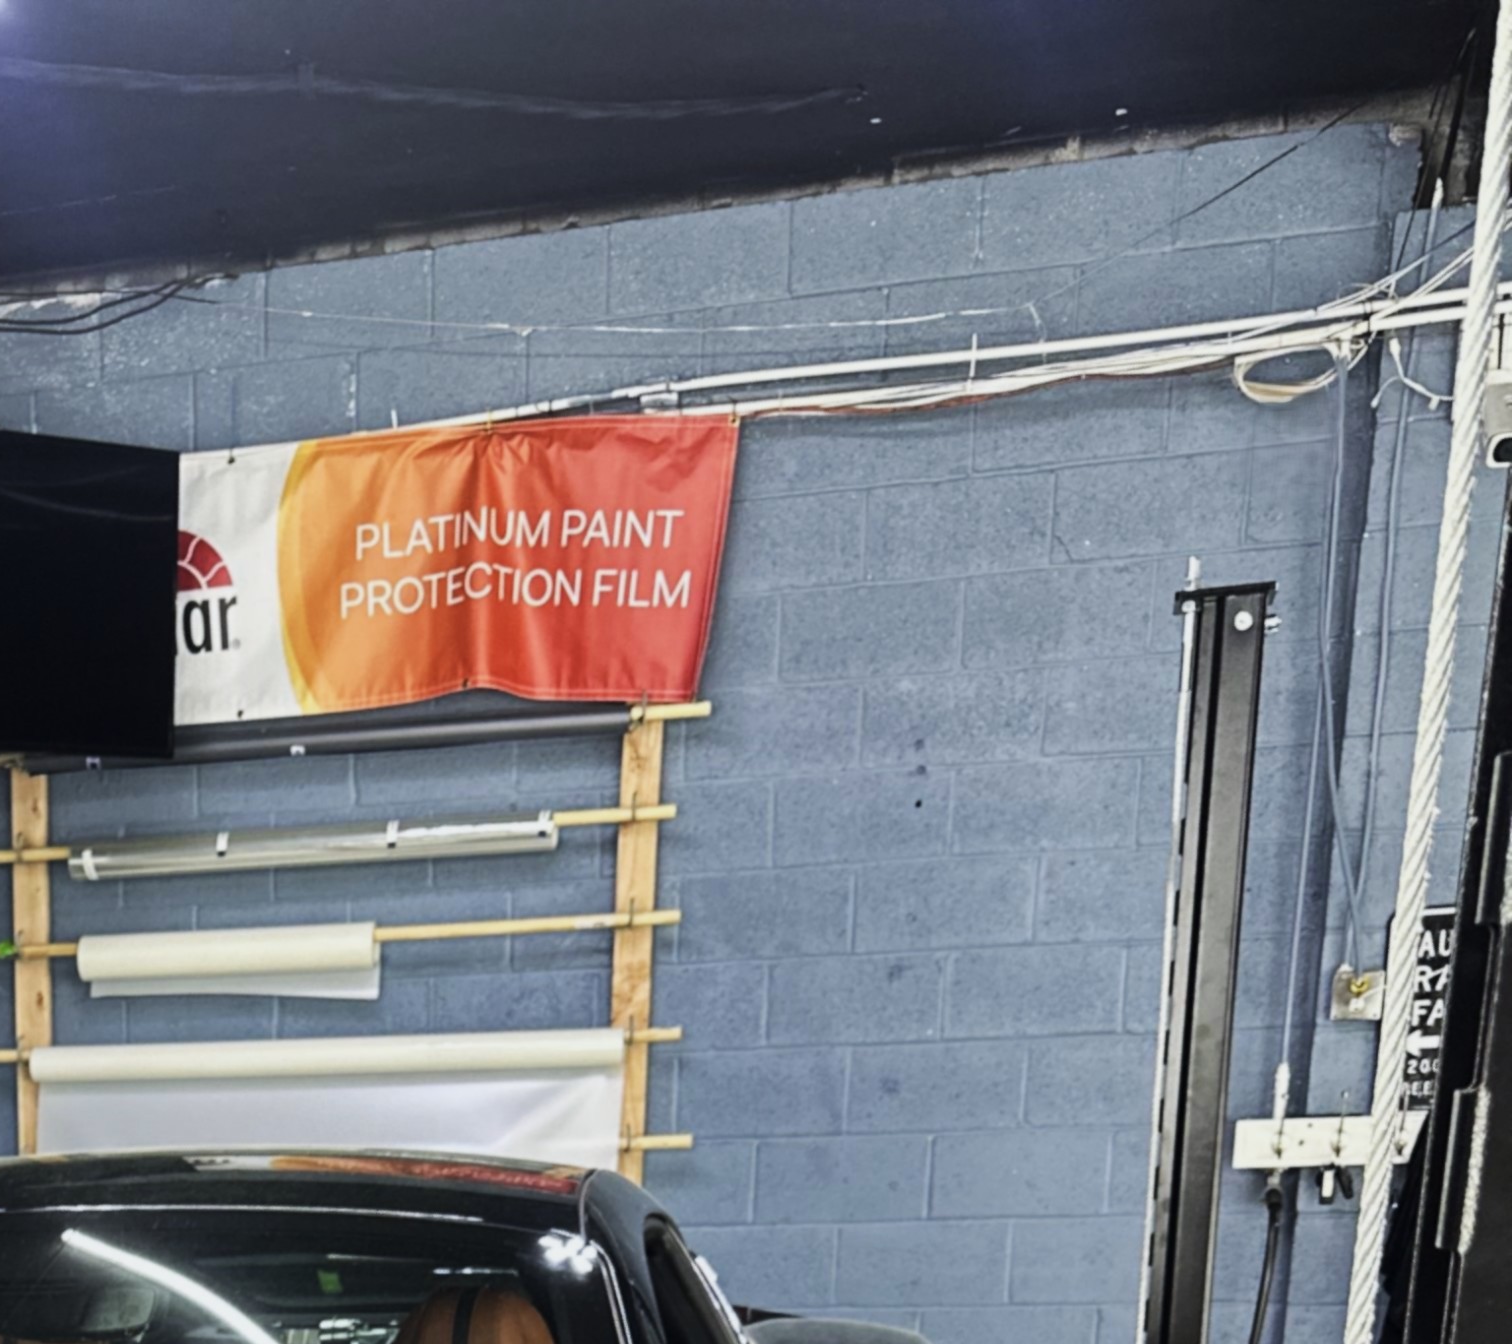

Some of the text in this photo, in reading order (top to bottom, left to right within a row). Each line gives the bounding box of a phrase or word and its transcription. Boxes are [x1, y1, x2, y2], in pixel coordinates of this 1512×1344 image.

[355, 506, 685, 561] PLATINUM PAINT
[339, 561, 691, 619] PROTECTION FILM
[182, 595, 238, 655] ar
[1418, 929, 1452, 958] AU
[1412, 998, 1446, 1027] FA
